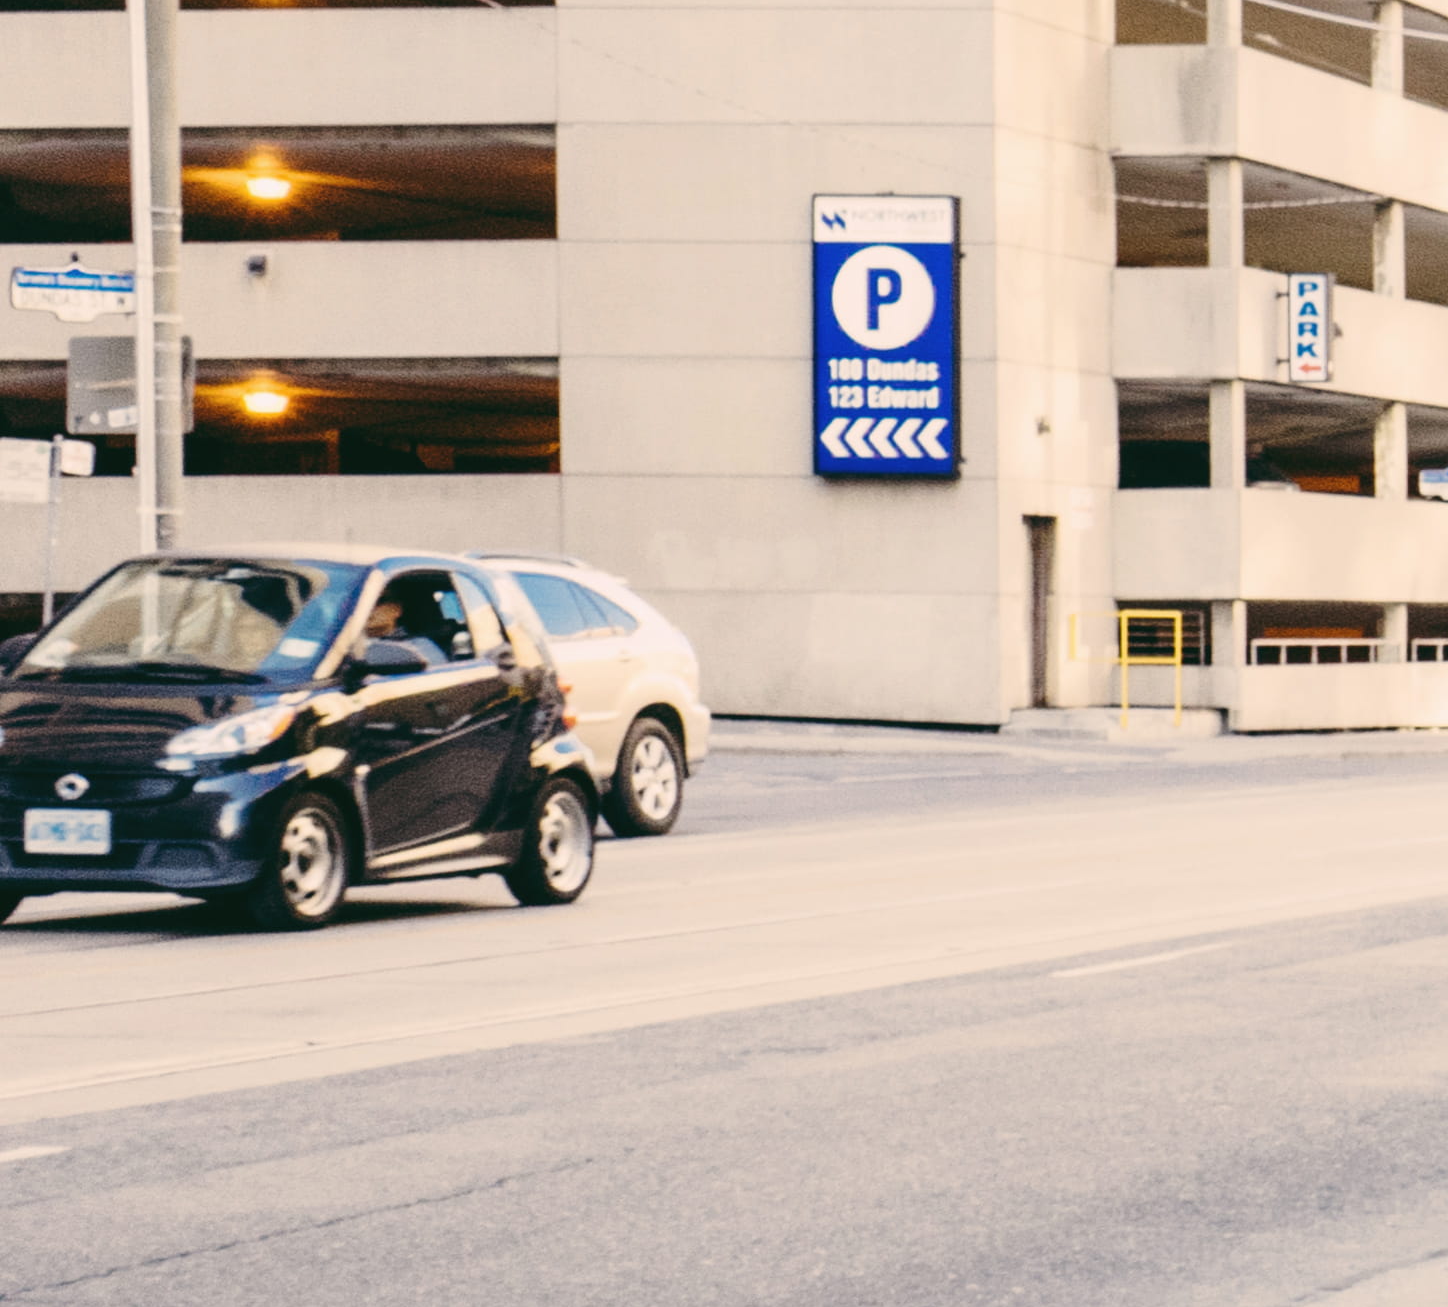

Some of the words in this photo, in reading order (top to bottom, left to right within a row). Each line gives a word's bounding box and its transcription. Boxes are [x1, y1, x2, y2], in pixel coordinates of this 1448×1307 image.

[866, 267, 902, 331] P
[1296, 282, 1319, 358] PARK
[867, 358, 940, 381] Dundas
[828, 385, 864, 409] 123
[867, 385, 940, 409] Edward
